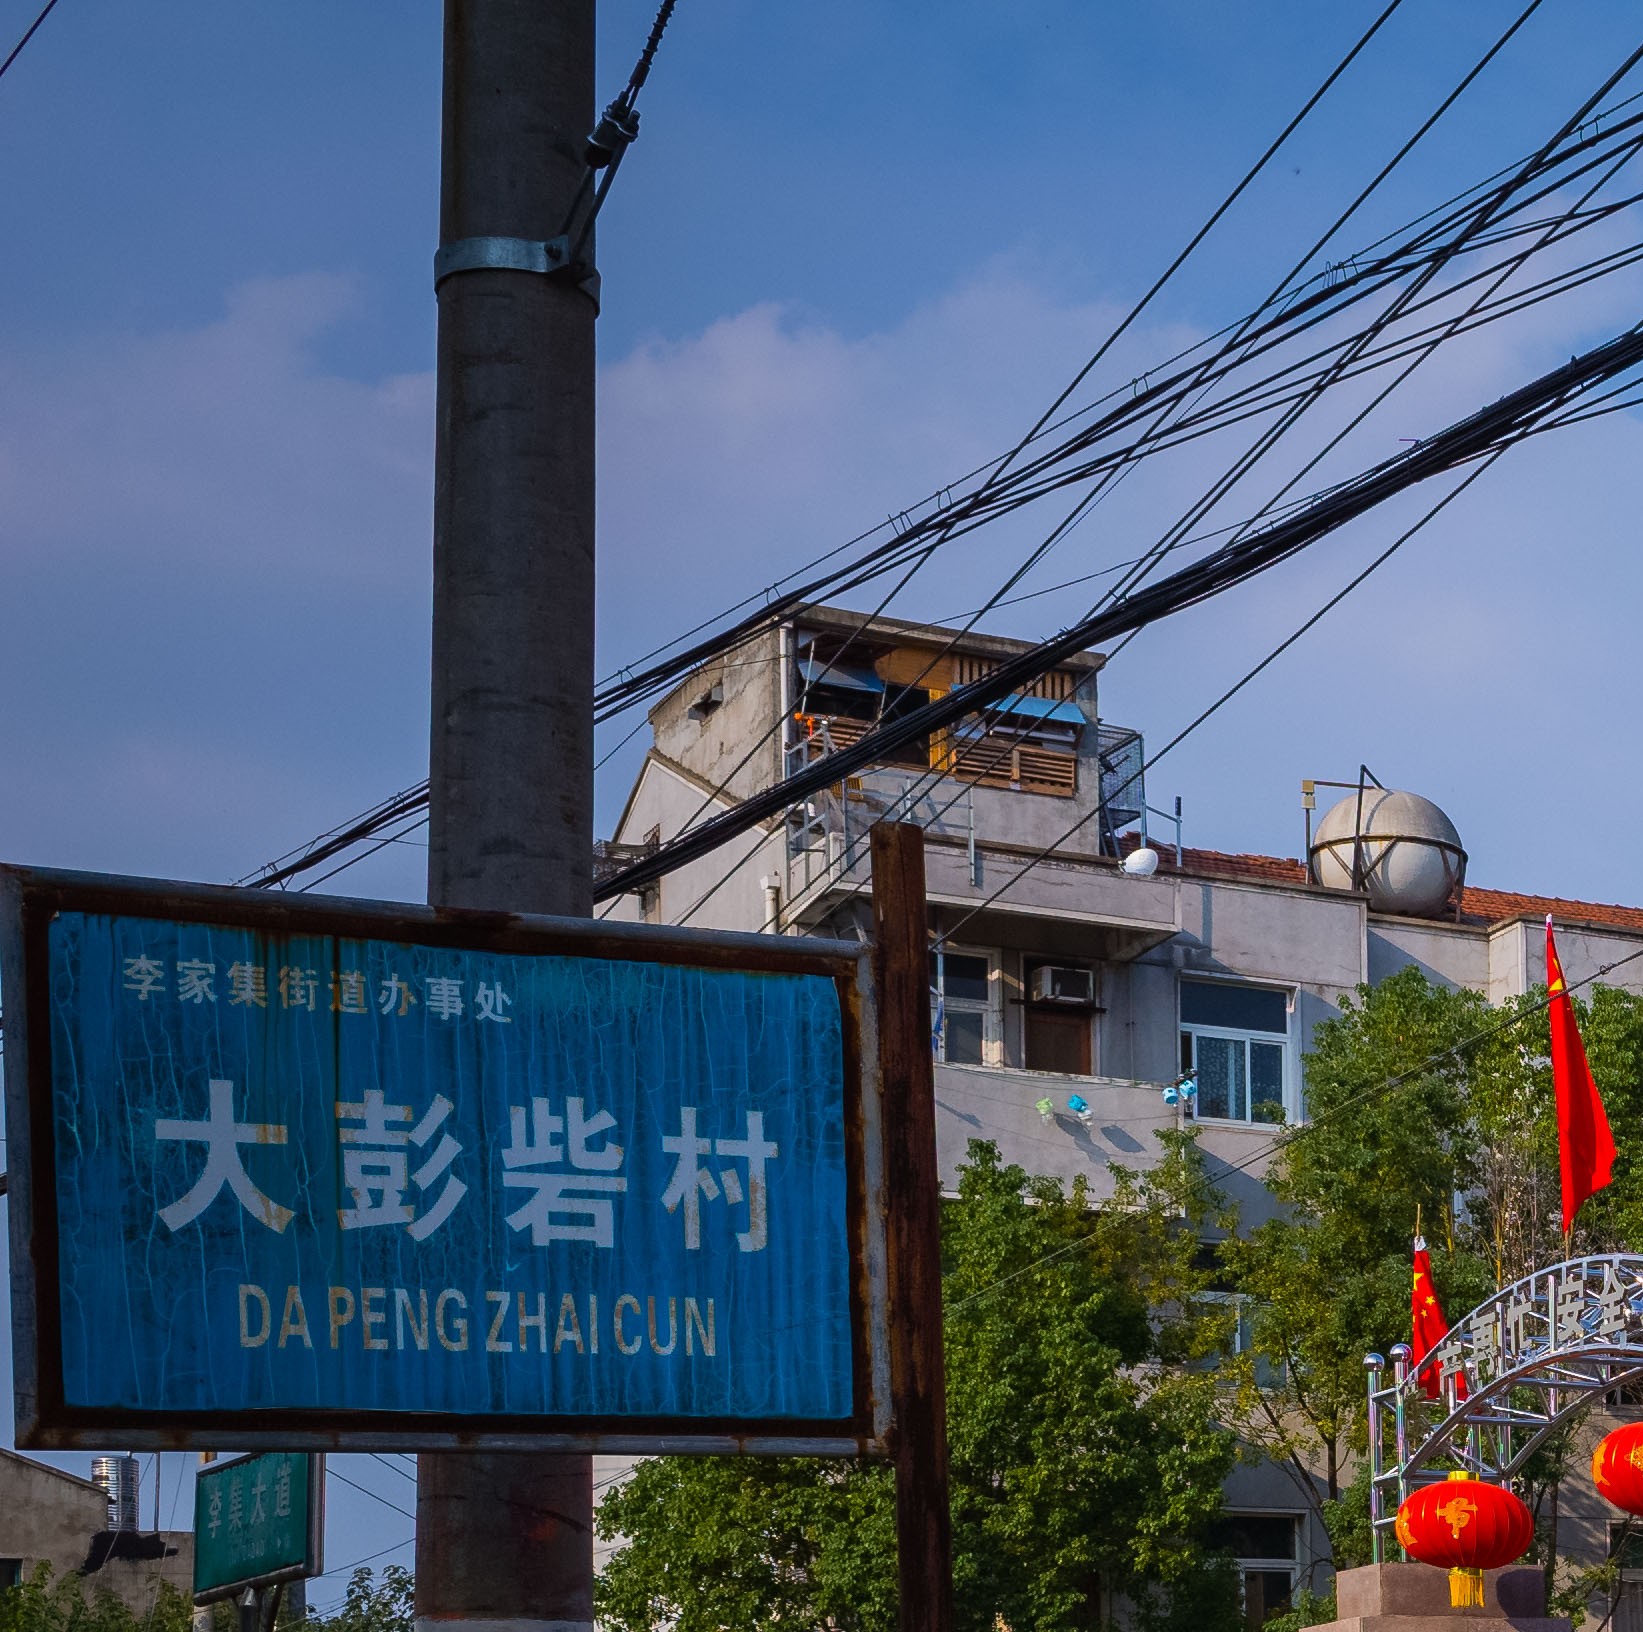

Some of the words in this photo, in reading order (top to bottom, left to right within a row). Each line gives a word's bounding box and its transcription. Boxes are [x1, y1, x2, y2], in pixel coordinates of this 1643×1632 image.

[123, 953, 514, 1024] 李家集街道办事处
[155, 1078, 779, 1253] 大彭砦村
[238, 1284, 312, 1349] DA
[330, 1286, 468, 1353] PENG
[485, 1291, 599, 1355] ZHAI
[614, 1294, 717, 1357] CUN
[207, 1463, 291, 1537] 李集大道
